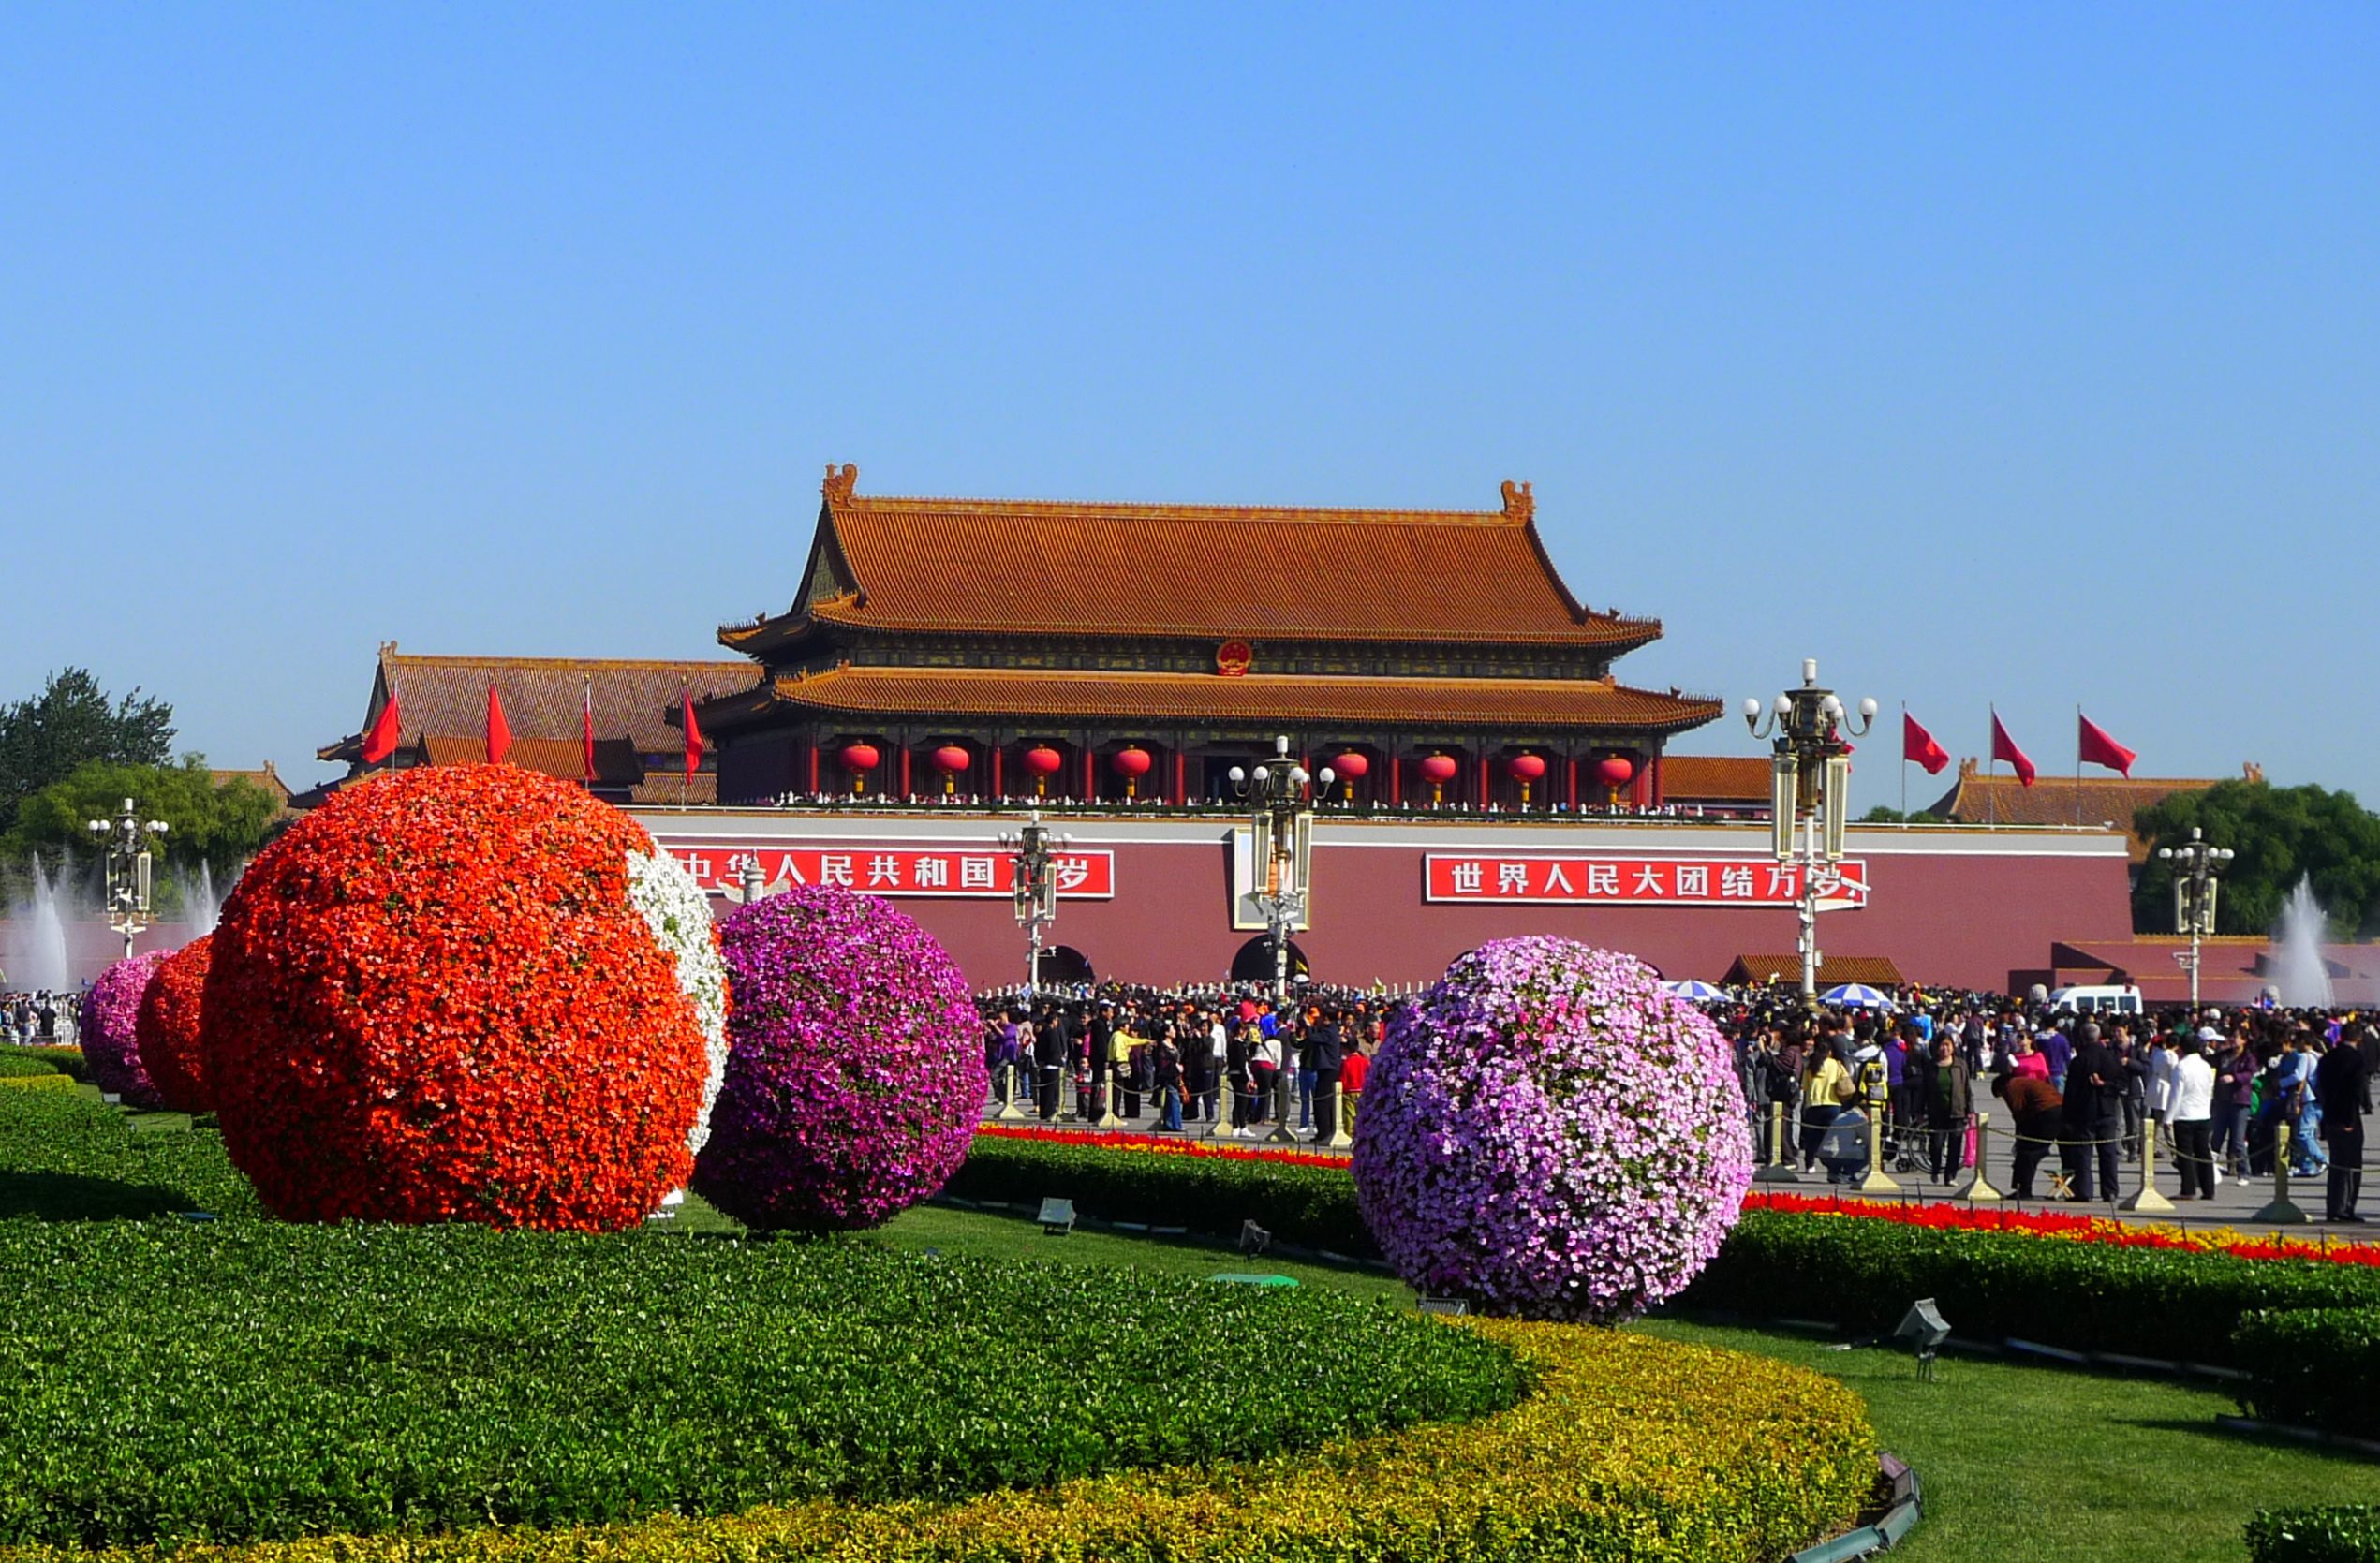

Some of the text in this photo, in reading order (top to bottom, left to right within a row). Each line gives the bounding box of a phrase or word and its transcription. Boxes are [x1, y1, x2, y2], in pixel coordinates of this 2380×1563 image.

[1451, 863, 1841, 897] 世界人民大团结万岁
